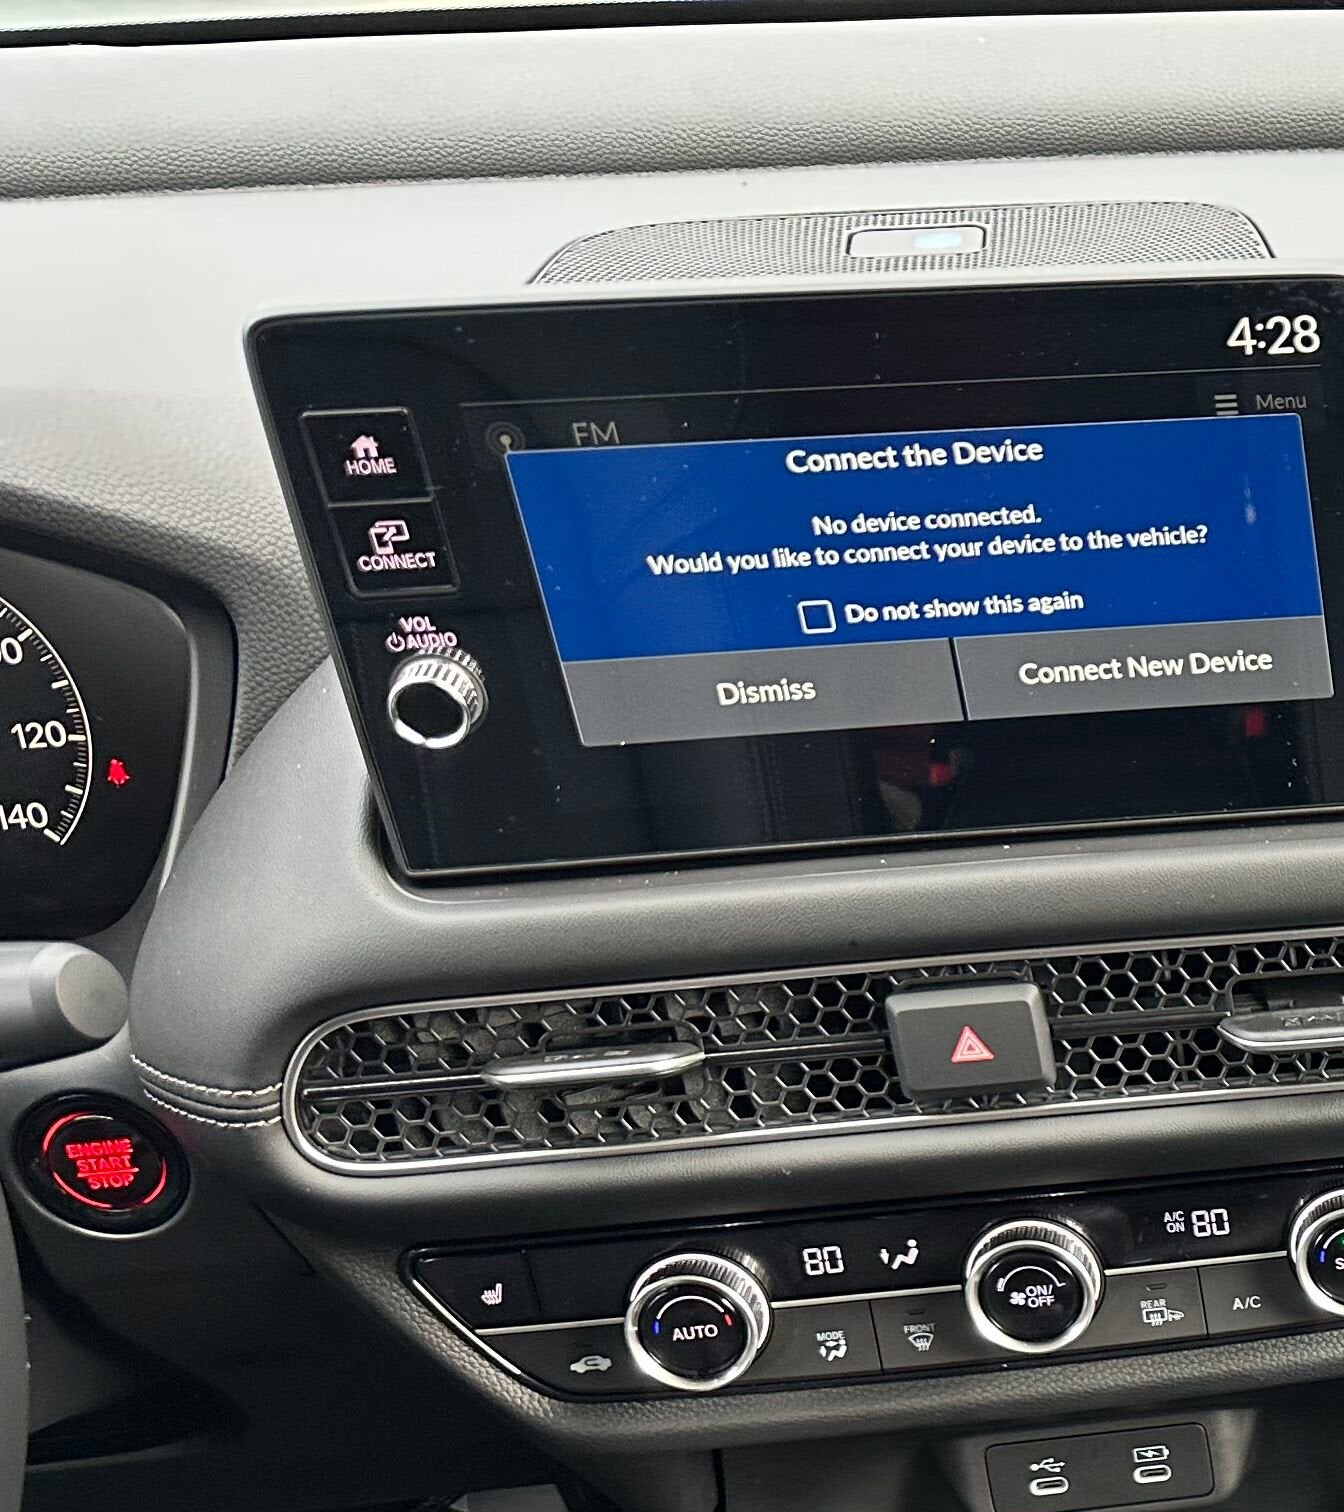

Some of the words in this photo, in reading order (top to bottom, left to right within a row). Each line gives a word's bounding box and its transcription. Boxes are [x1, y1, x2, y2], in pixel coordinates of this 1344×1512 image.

[1226, 314, 1321, 356] 4:28
[1255, 393, 1307, 411] Menu
[571, 421, 621, 446] FM
[785, 446, 899, 474] Connect
[902, 442, 948, 467] the
[951, 439, 1044, 465] Device
[345, 458, 397, 476] HOME
[811, 514, 848, 537] No
[850, 511, 921, 534] device
[924, 504, 1042, 531] connected.
[646, 551, 723, 576] Would
[725, 552, 769, 575] you
[772, 547, 811, 568] like
[814, 547, 840, 567] to
[843, 540, 936, 564] connect
[934, 539, 982, 562] your
[987, 533, 1056, 556] device
[1059, 532, 1083, 551] to
[1087, 529, 1123, 550] the
[1125, 524, 1208, 547] vehicle?
[357, 551, 436, 572] CONNECT
[844, 603, 879, 624] Do
[882, 601, 920, 620] not
[923, 597, 980, 620] show
[983, 594, 1024, 615] this
[1027, 591, 1084, 615] again
[399, 616, 436, 633] VOL
[406, 632, 458, 650] AUDIO
[1018, 658, 1123, 686] Connect
[1126, 654, 1184, 679] New
[1190, 648, 1273, 675] Device
[716, 678, 816, 706] Dismiss
[11, 720, 67, 749] 120
[65, 1138, 134, 1159] ENGINE
[76, 1155, 132, 1172] START
[87, 1173, 135, 1190] STOP
[1163, 1210, 1185, 1223] A/C
[1191, 1208, 1231, 1238] 80
[1166, 1221, 1185, 1234] ON
[802, 1245, 846, 1277] 80
[1025, 1284, 1053, 1298] ON/
[1028, 1295, 1055, 1309] OFF
[1140, 1298, 1167, 1309] REAR
[1232, 1296, 1262, 1311] A/C
[672, 1323, 719, 1342] AUTO
[816, 1330, 846, 1342] MODE
[903, 1322, 936, 1335] FRONT
